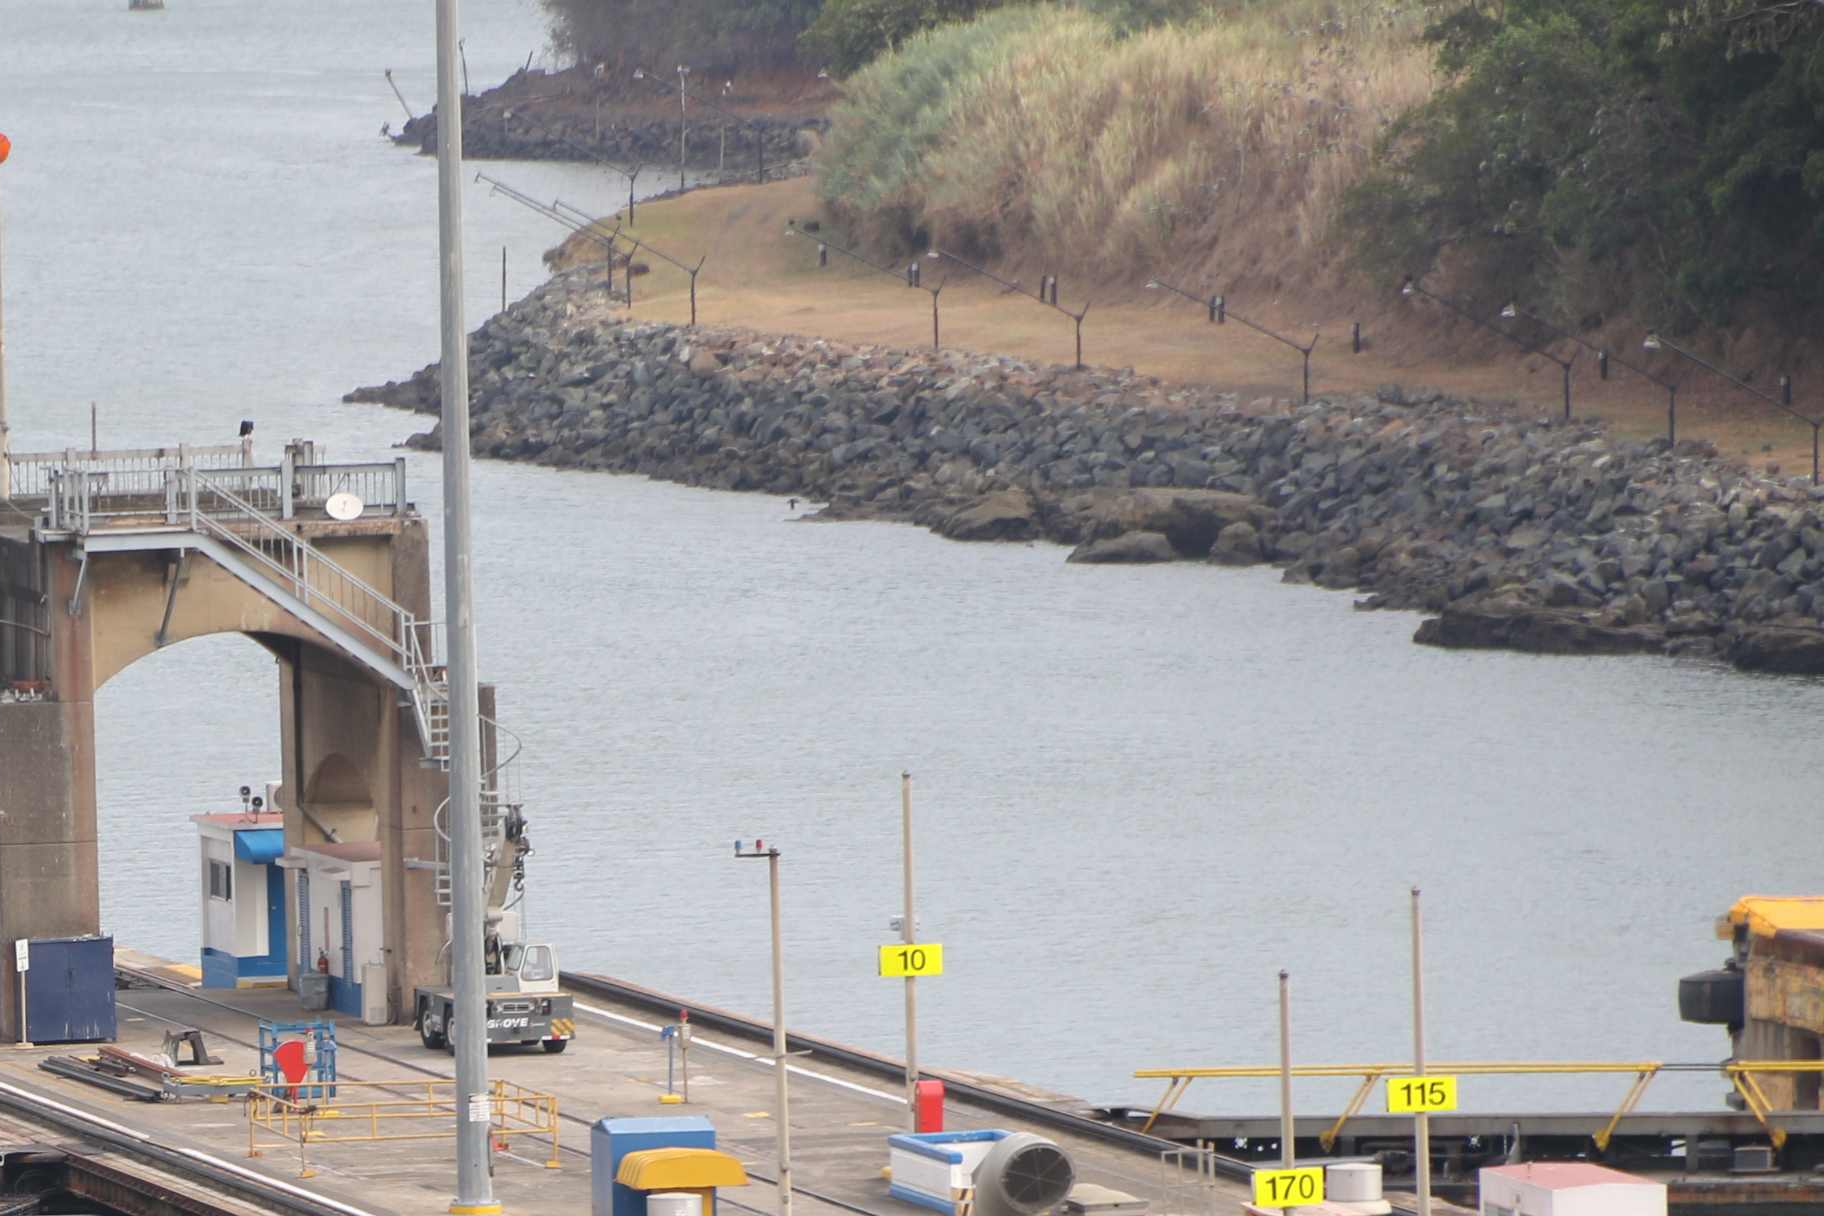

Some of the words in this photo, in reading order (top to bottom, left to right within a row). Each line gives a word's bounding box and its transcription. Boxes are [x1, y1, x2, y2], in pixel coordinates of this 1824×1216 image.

[897, 949, 926, 971] 10
[1401, 1082, 1446, 1107] 115
[1266, 1174, 1315, 1201] 170
